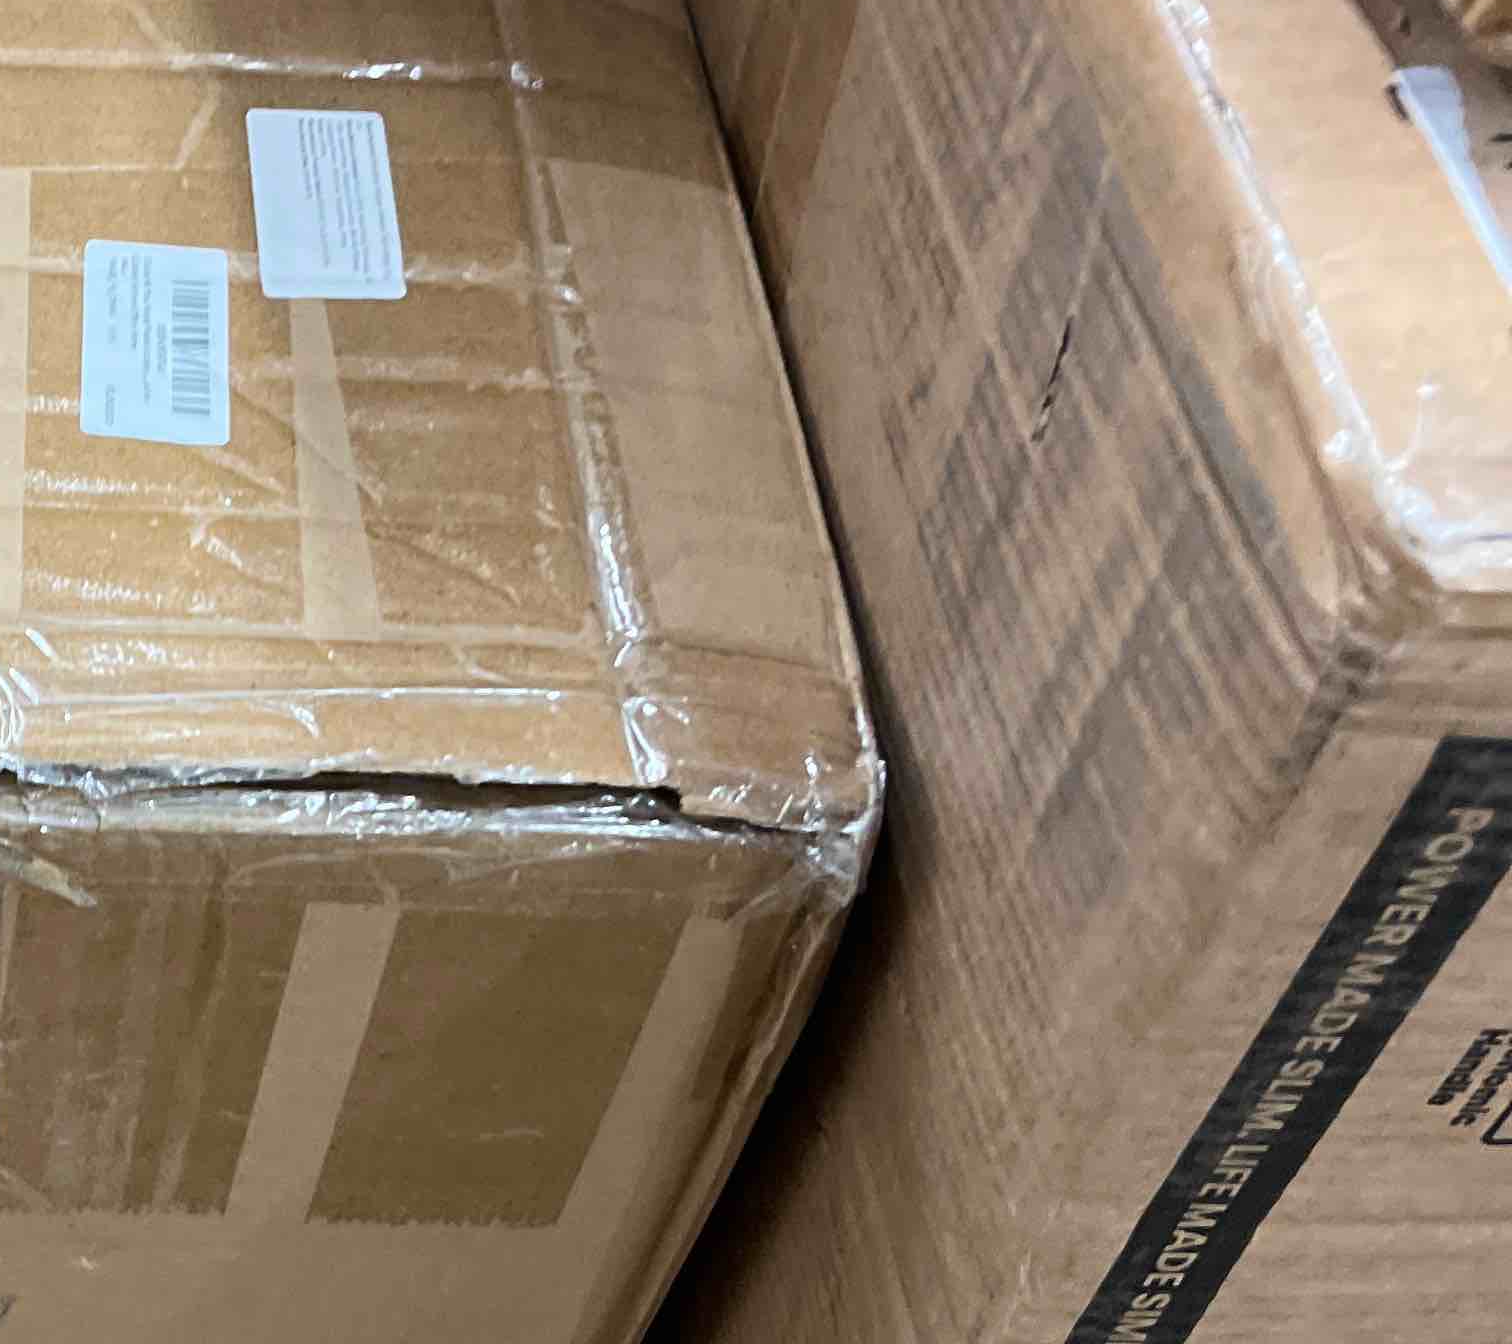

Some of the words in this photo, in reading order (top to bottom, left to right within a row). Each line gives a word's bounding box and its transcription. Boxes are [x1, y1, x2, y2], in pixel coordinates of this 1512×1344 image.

[1365, 807, 1492, 948] POWER
[1294, 955, 1390, 1055] MADE
[1237, 1058, 1324, 1143] SLIM.
[1427, 1029, 1511, 1105] Handle
[1198, 1144, 1269, 1202] LIFE
[1143, 1203, 1226, 1288] MADE
